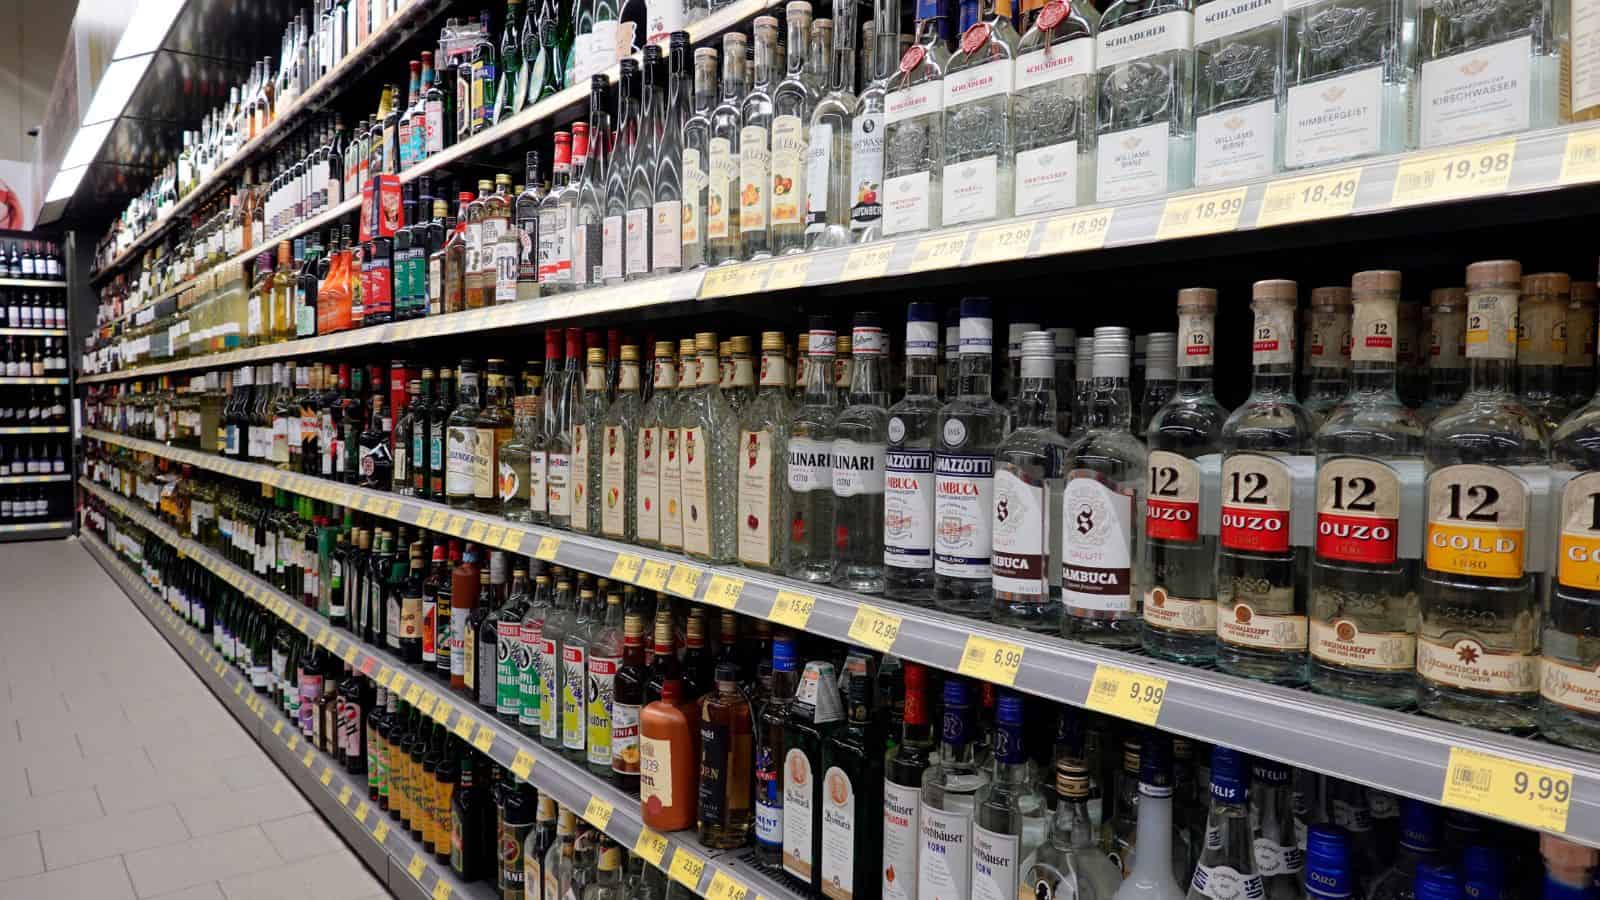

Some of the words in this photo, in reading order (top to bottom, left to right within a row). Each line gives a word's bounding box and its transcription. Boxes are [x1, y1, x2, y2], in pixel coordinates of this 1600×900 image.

[1106, 24, 1166, 48] SCHLADERER
[1432, 79, 1517, 105] KIRSCHWASSER
[1299, 106, 1368, 128] HIMBEERGEIST
[1443, 152, 1510, 182] 19,98
[1300, 180, 1357, 206] 18,49
[1195, 197, 1243, 220] 18,99
[1070, 217, 1108, 236] 18,99
[1193, 334, 1204, 344] 12
[1258, 328, 1271, 340] 12
[1374, 322, 1388, 335] 12
[1150, 466, 1179, 496] 12
[1230, 471, 1269, 505] 12
[1331, 476, 1377, 513] 12
[1447, 483, 1500, 523] 12
[1222, 513, 1282, 531] OUZO
[1320, 521, 1391, 542] OUZO
[1432, 531, 1516, 554] GOLD
[1452, 557, 1488, 570] 1880
[871, 619, 897, 640] 12,99
[993, 648, 1022, 669] 6,99
[1129, 681, 1164, 705] 9,99
[1209, 781, 1236, 798] TELIS
[1513, 771, 1570, 803] 9,99
[1310, 871, 1337, 888] Ouzo
